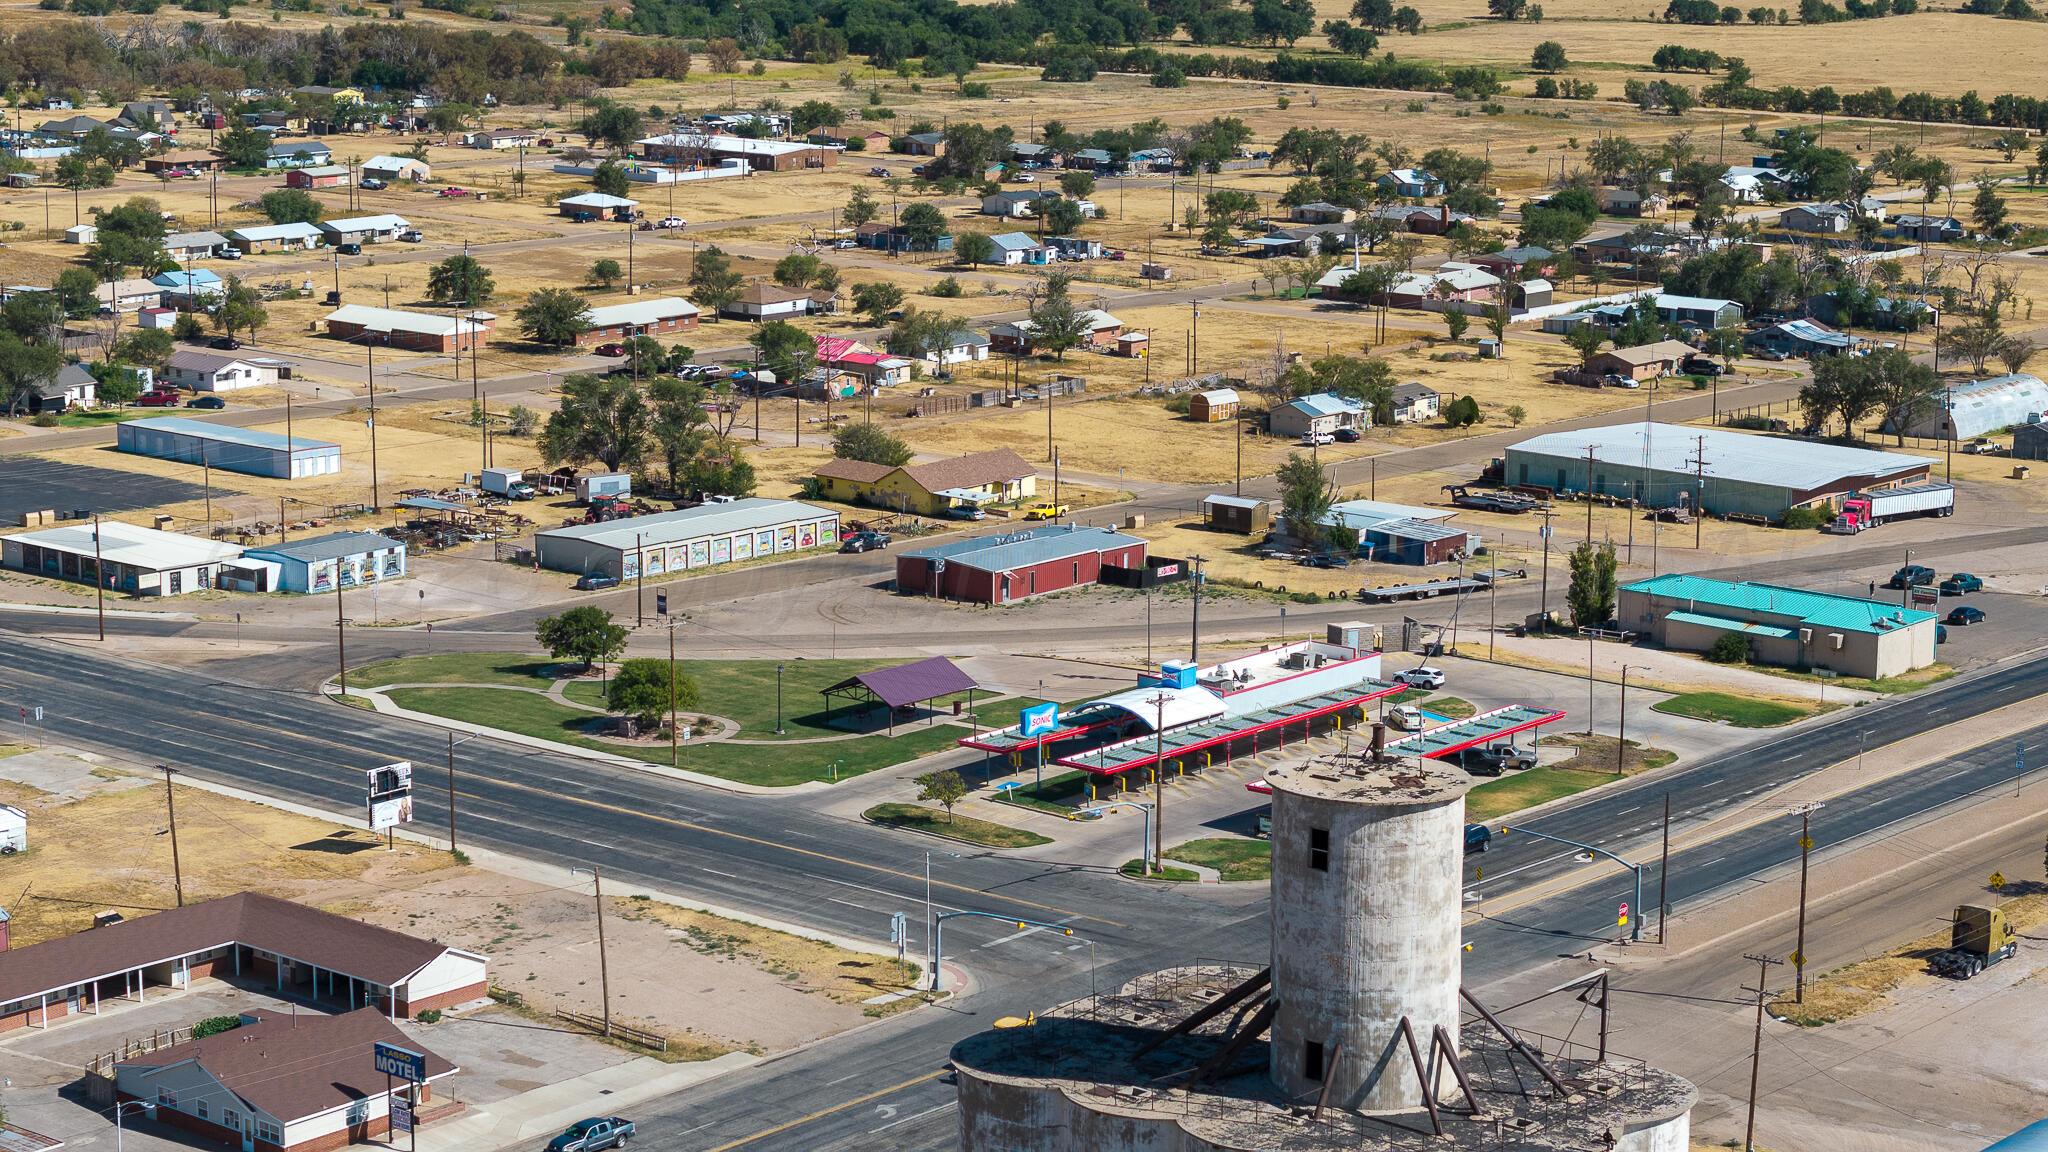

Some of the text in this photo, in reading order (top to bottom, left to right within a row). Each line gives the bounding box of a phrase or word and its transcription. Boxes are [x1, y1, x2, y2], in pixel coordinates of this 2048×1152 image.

[1031, 714, 1051, 726] SONIC
[383, 1048, 412, 1062] LASSO
[376, 1054, 419, 1081] MOTEL
